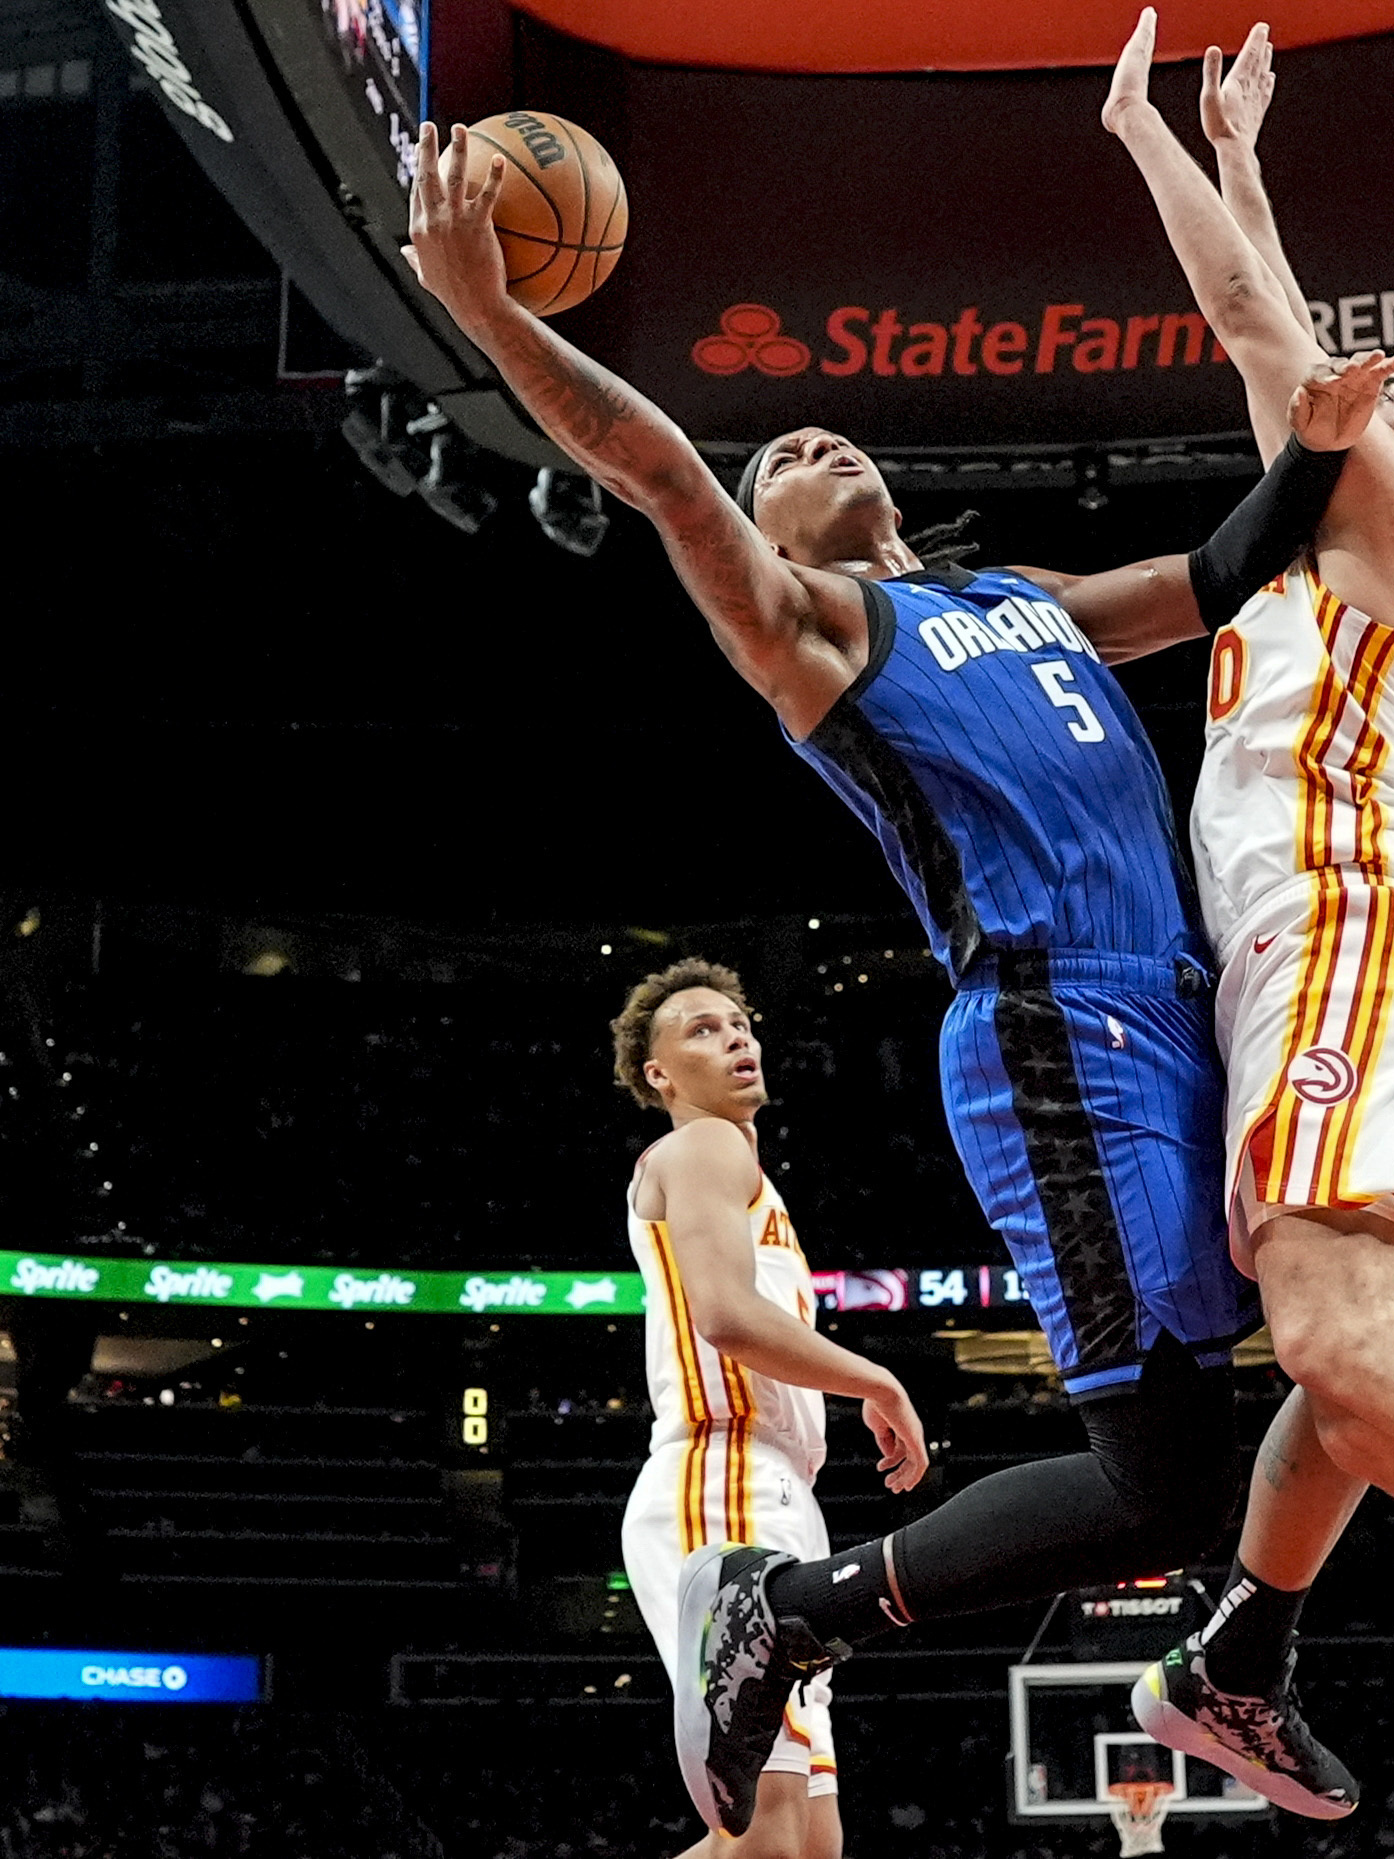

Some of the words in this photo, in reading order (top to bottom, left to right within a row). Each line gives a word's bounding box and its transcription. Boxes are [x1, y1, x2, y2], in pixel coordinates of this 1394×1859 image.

[1208, 627, 1248, 723] 0
[1030, 659, 1106, 743] 5
[10, 1258, 100, 1294] Sprite
[144, 1265, 233, 1302] Sprite
[328, 1273, 416, 1309] Sprite
[459, 1276, 547, 1312] Sprite
[919, 1270, 967, 1306] 54
[1003, 1270, 1030, 1301] 1
[1109, 1597, 1183, 1617] TISSOT
[81, 1656, 161, 1687] CHASE
